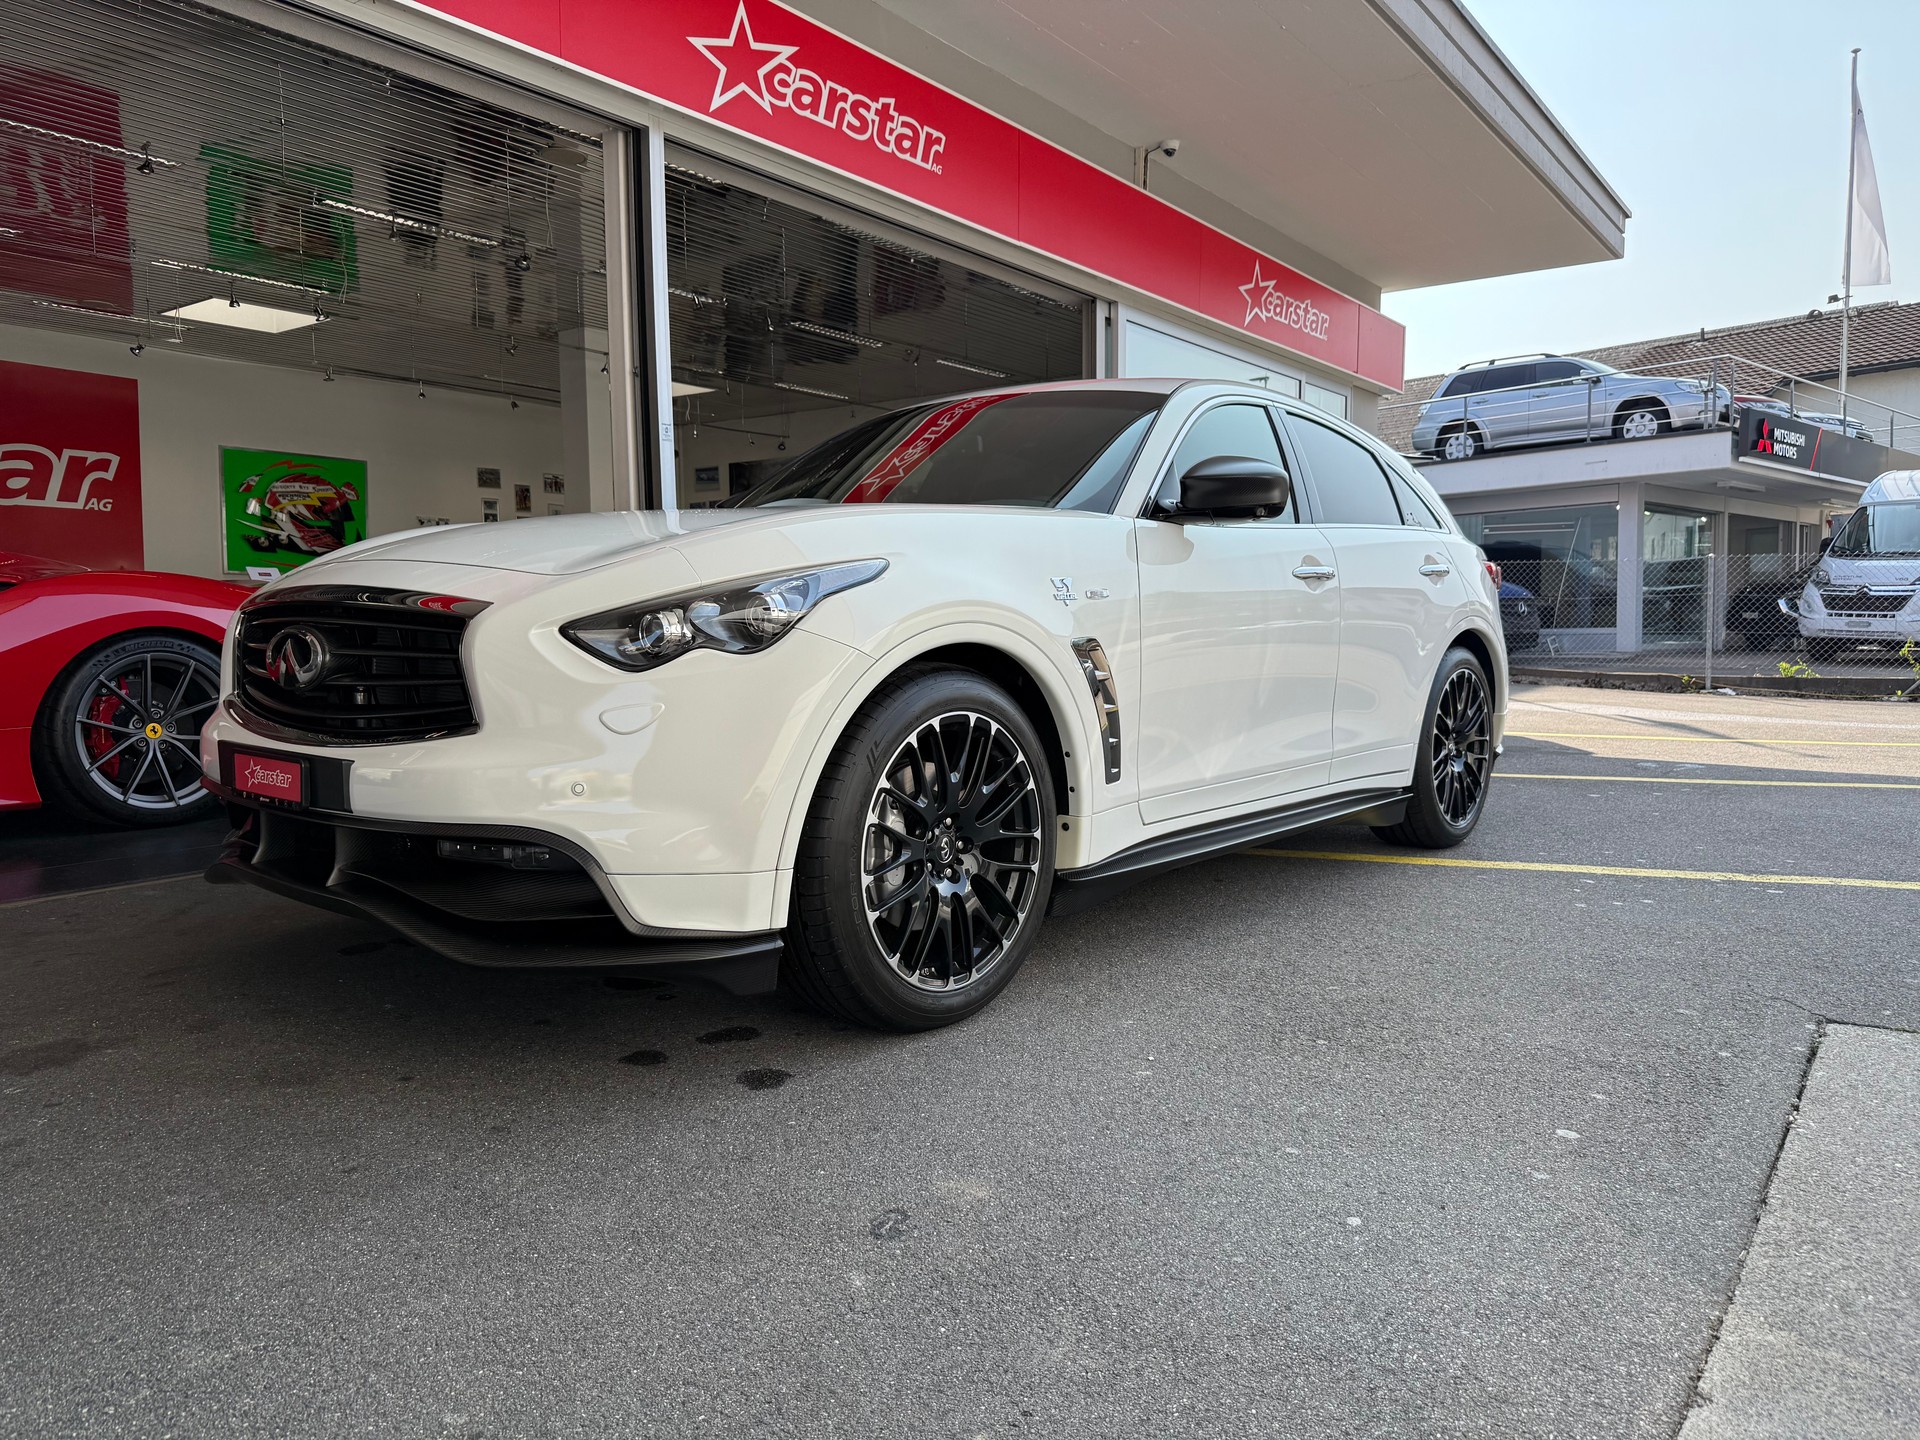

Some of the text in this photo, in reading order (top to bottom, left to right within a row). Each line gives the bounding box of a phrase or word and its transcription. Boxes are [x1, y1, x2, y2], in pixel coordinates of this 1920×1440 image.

[760, 58, 946, 175] carstar AG
[1262, 288, 1330, 339] carstar
[1773, 427, 1806, 447] MITSUBISHI
[1773, 442, 1798, 459] MOTORS
[84, 498, 113, 512] AG
[125, 641, 174, 651] MICHELIN
[255, 769, 292, 788] carstar
